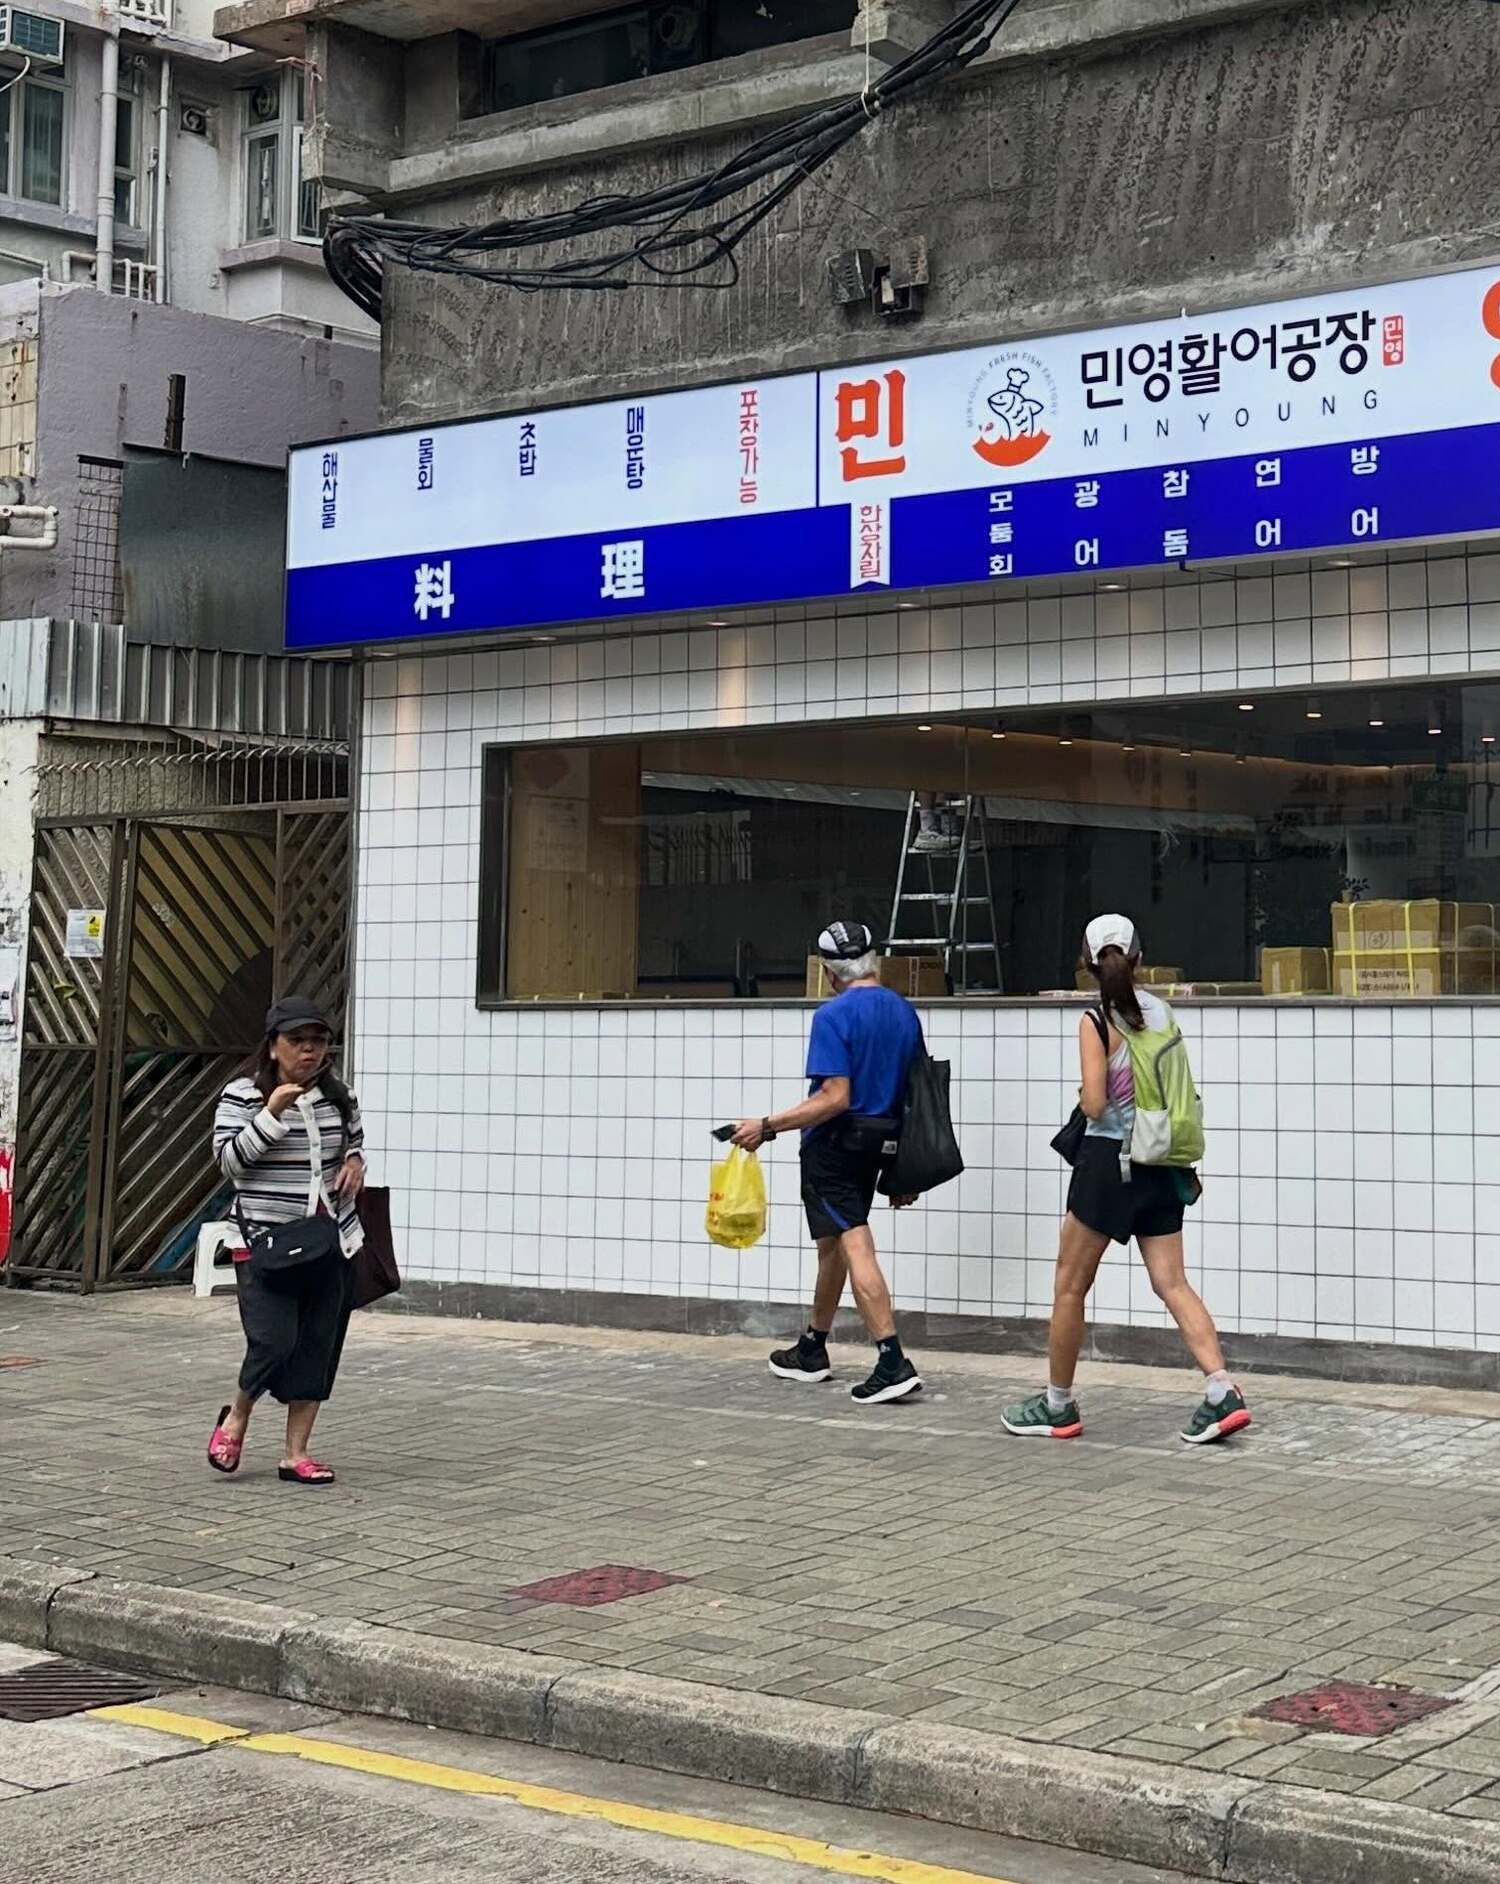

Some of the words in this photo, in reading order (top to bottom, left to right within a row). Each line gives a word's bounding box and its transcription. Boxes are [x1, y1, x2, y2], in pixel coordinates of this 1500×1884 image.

[988, 352, 1018, 368] FRESH
[1022, 352, 1042, 368] FISH
[1081, 310, 1376, 409] 민영활어공장
[1384, 317, 1402, 363] 민영
[519, 422, 536, 477] 초밥
[626, 406, 645, 490] 매운탕
[740, 389, 758, 504] 포장가능
[835, 369, 906, 482] 민
[1083, 390, 1379, 447] MINYOUNG
[321, 452, 339, 529] 해산물
[417, 438, 434, 491] 물회
[1255, 458, 1281, 547] 연어
[1351, 445, 1380, 537] 방어
[1074, 481, 1101, 566] 광어
